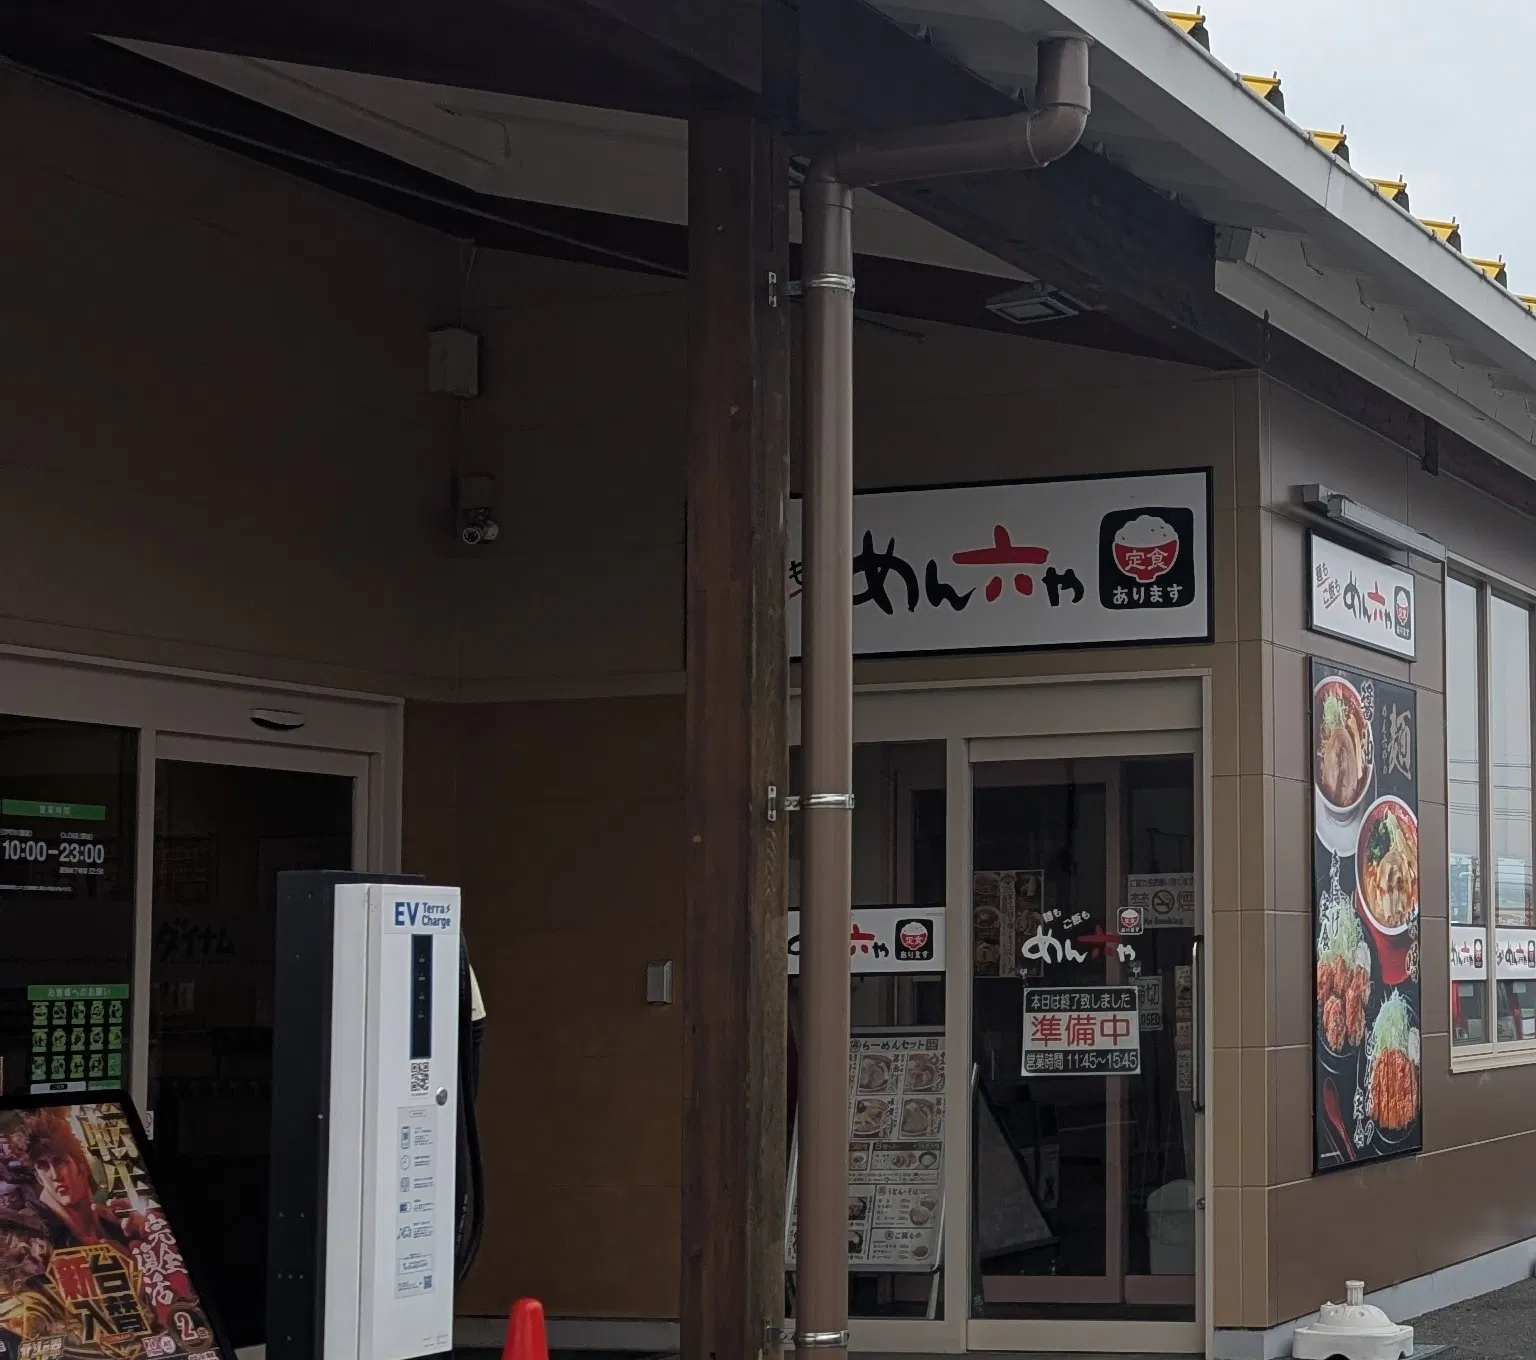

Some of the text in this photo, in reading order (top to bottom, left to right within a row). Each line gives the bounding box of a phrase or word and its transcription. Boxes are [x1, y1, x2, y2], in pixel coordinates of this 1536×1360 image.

[1125, 547, 1168, 570] 定食
[1113, 584, 1183, 604] あります
[394, 902, 420, 926] EV
[422, 902, 445, 914] Terra
[422, 915, 451, 929] Charge
[1022, 924, 1136, 964] めん六や
[1030, 993, 1131, 1010] 本日は終了致しました
[1030, 1014, 1131, 1047] 準備中
[1026, 1052, 1063, 1070] 営業時間
